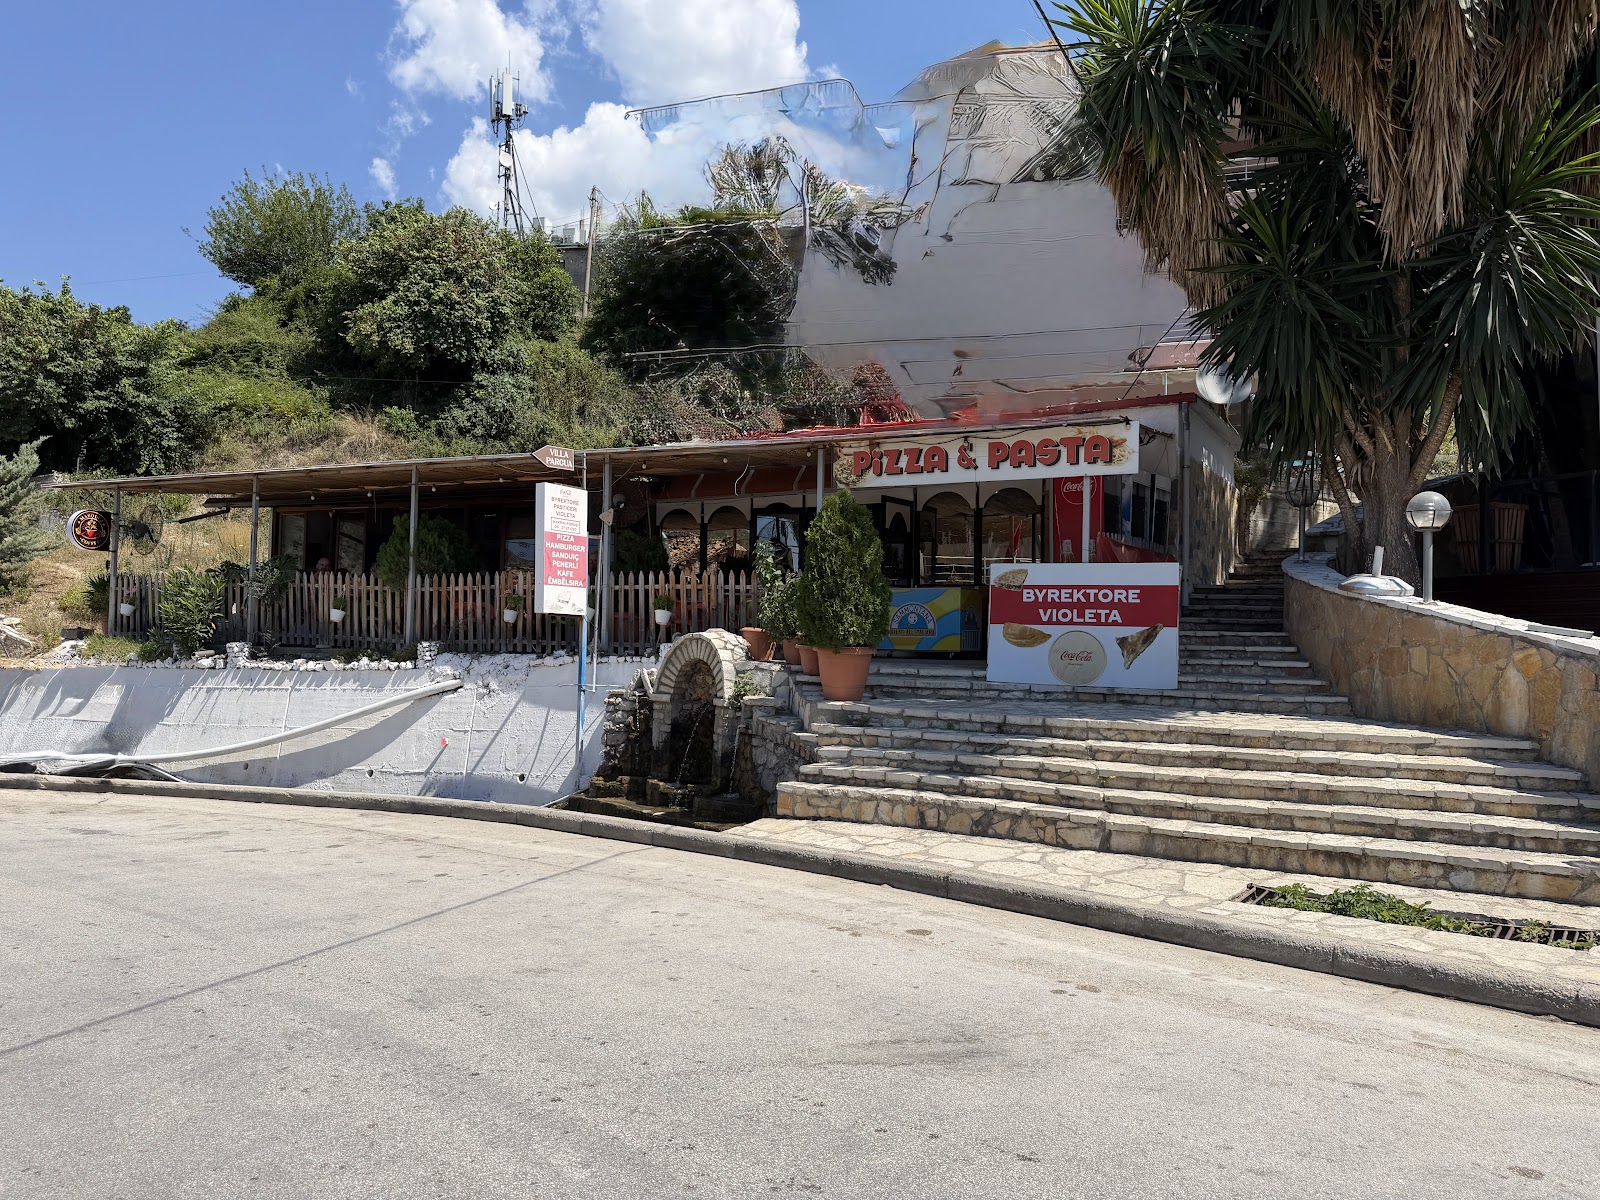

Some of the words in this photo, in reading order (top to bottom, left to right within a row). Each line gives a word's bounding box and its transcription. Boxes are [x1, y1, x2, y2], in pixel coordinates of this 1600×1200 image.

[549, 448, 569, 459] VILLA
[957, 442, 978, 470] &
[987, 435, 1113, 470] PASTA
[553, 504, 578, 513] PASTICERI
[555, 510, 576, 519] VIOLETA
[556, 534, 575, 542] PIZZA
[546, 541, 585, 552] HAMBURGER
[552, 550, 579, 561] SANDUIÇ
[558, 569, 574, 578] KAFE
[1022, 588, 1141, 604] BYREKTORE
[893, 605, 933, 624] SAMMONTANA
[1038, 609, 1122, 623] VIOLETA
